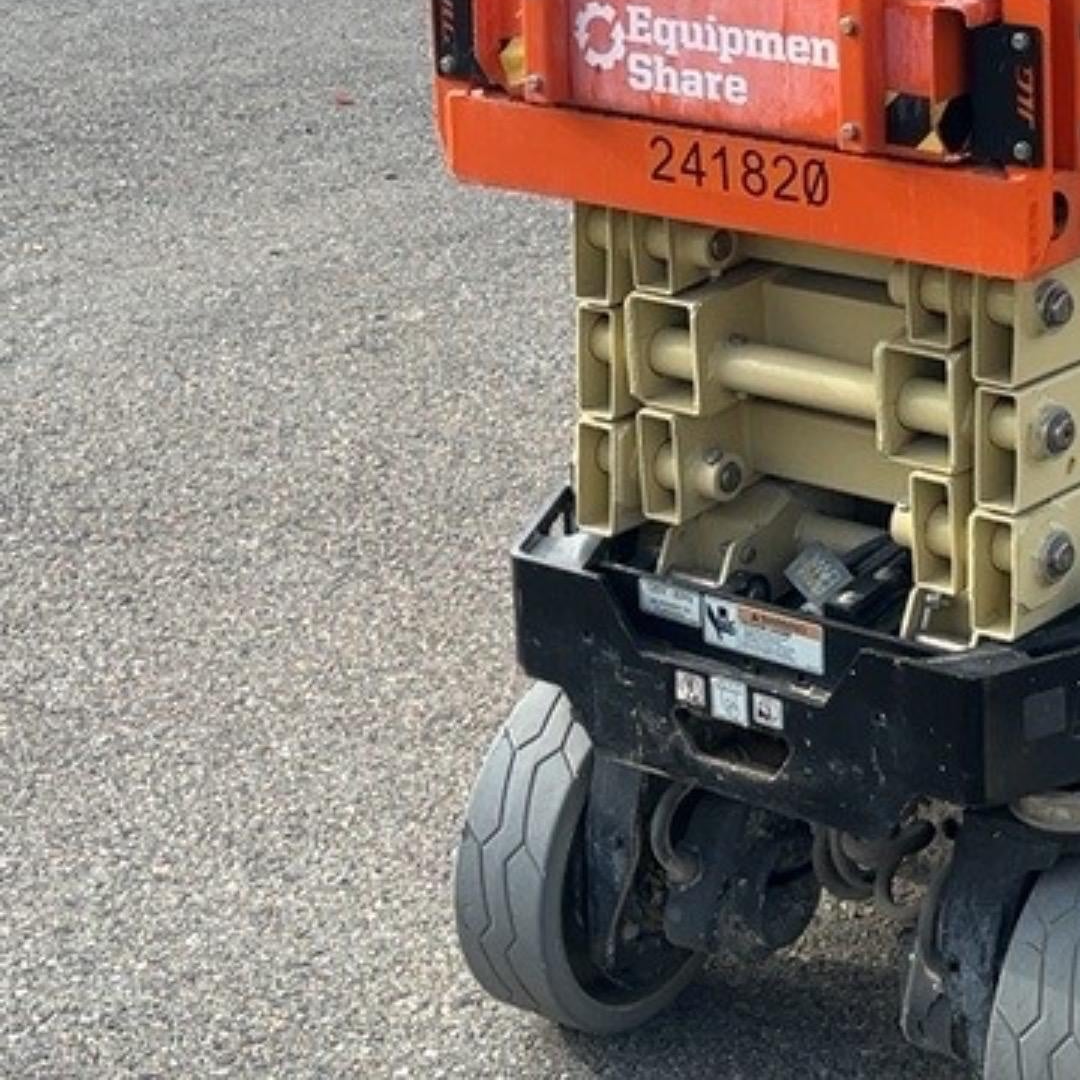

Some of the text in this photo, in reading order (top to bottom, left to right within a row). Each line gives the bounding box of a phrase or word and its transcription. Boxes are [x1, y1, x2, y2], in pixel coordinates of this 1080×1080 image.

[625, 3, 840, 70] Equipmen
[625, 52, 749, 107] Share
[649, 134, 831, 207] 241820
